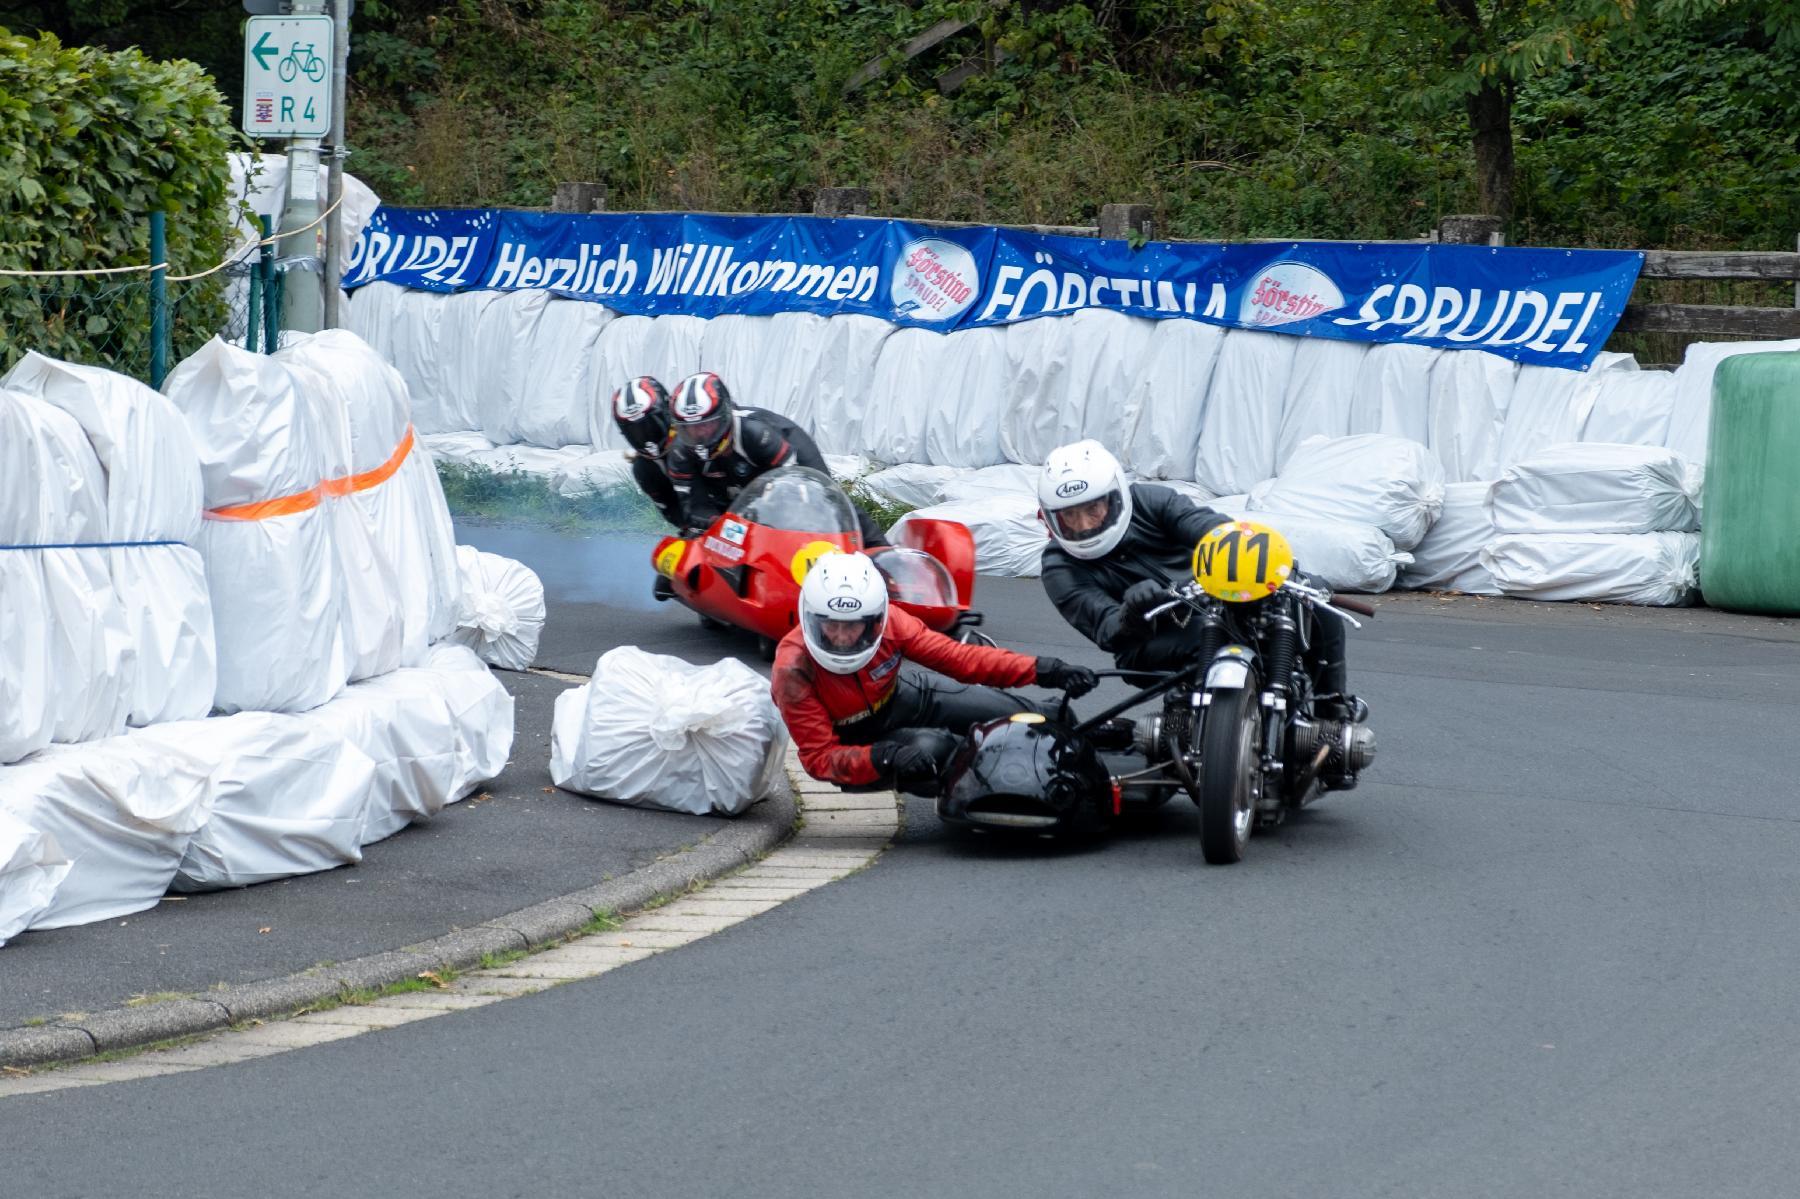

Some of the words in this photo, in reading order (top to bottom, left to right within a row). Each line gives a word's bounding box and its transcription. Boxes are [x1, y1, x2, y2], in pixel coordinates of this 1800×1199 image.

[280, 96, 295, 122] R
[303, 96, 315, 122] 4
[486, 242, 638, 295] Herzlich
[643, 243, 880, 302] Willkommen
[1251, 277, 1333, 316] Förstin
[1332, 283, 1602, 354] SPRUDEL
[1061, 480, 1085, 494] Arai
[831, 598, 859, 609] Arai
